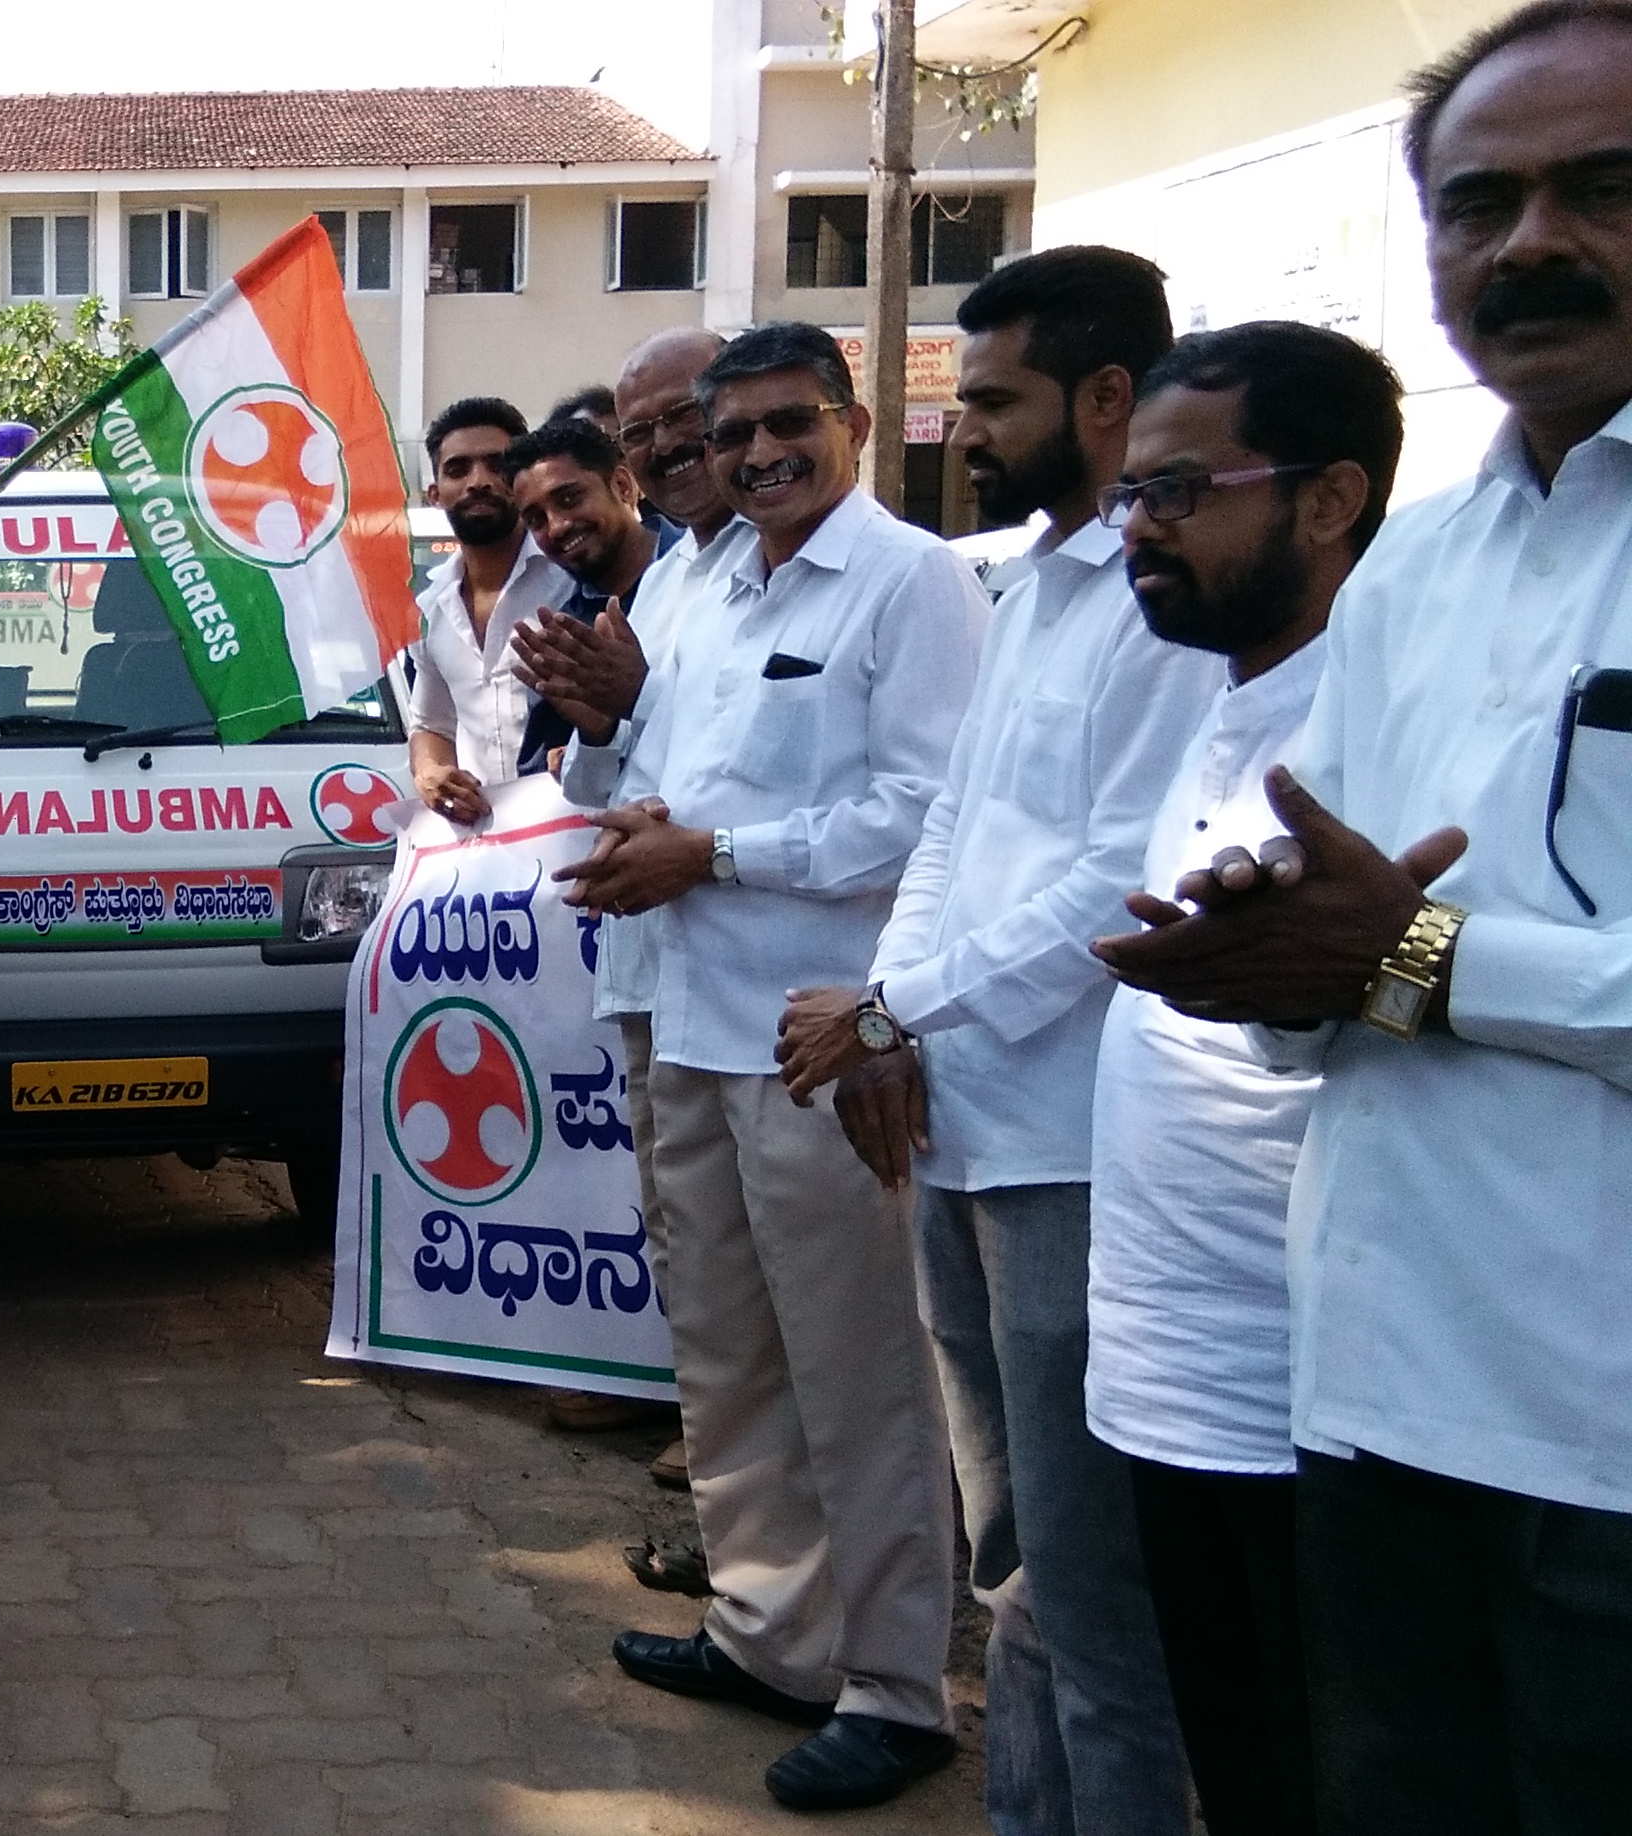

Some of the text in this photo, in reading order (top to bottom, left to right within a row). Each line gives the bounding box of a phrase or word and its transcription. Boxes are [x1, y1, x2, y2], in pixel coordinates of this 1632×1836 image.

[102, 398, 240, 662] YOUTH CONGRESS
[83, 877, 166, 934] ಪುತ್ತೂರು
[174, 875, 274, 925] ವಿಧಾನಸಭಾ
[389, 858, 543, 984] ಯುವ
[15, 1086, 64, 1105] KA
[127, 1081, 205, 1101] 6370
[413, 1205, 667, 1317] ವಿಧಾನ
